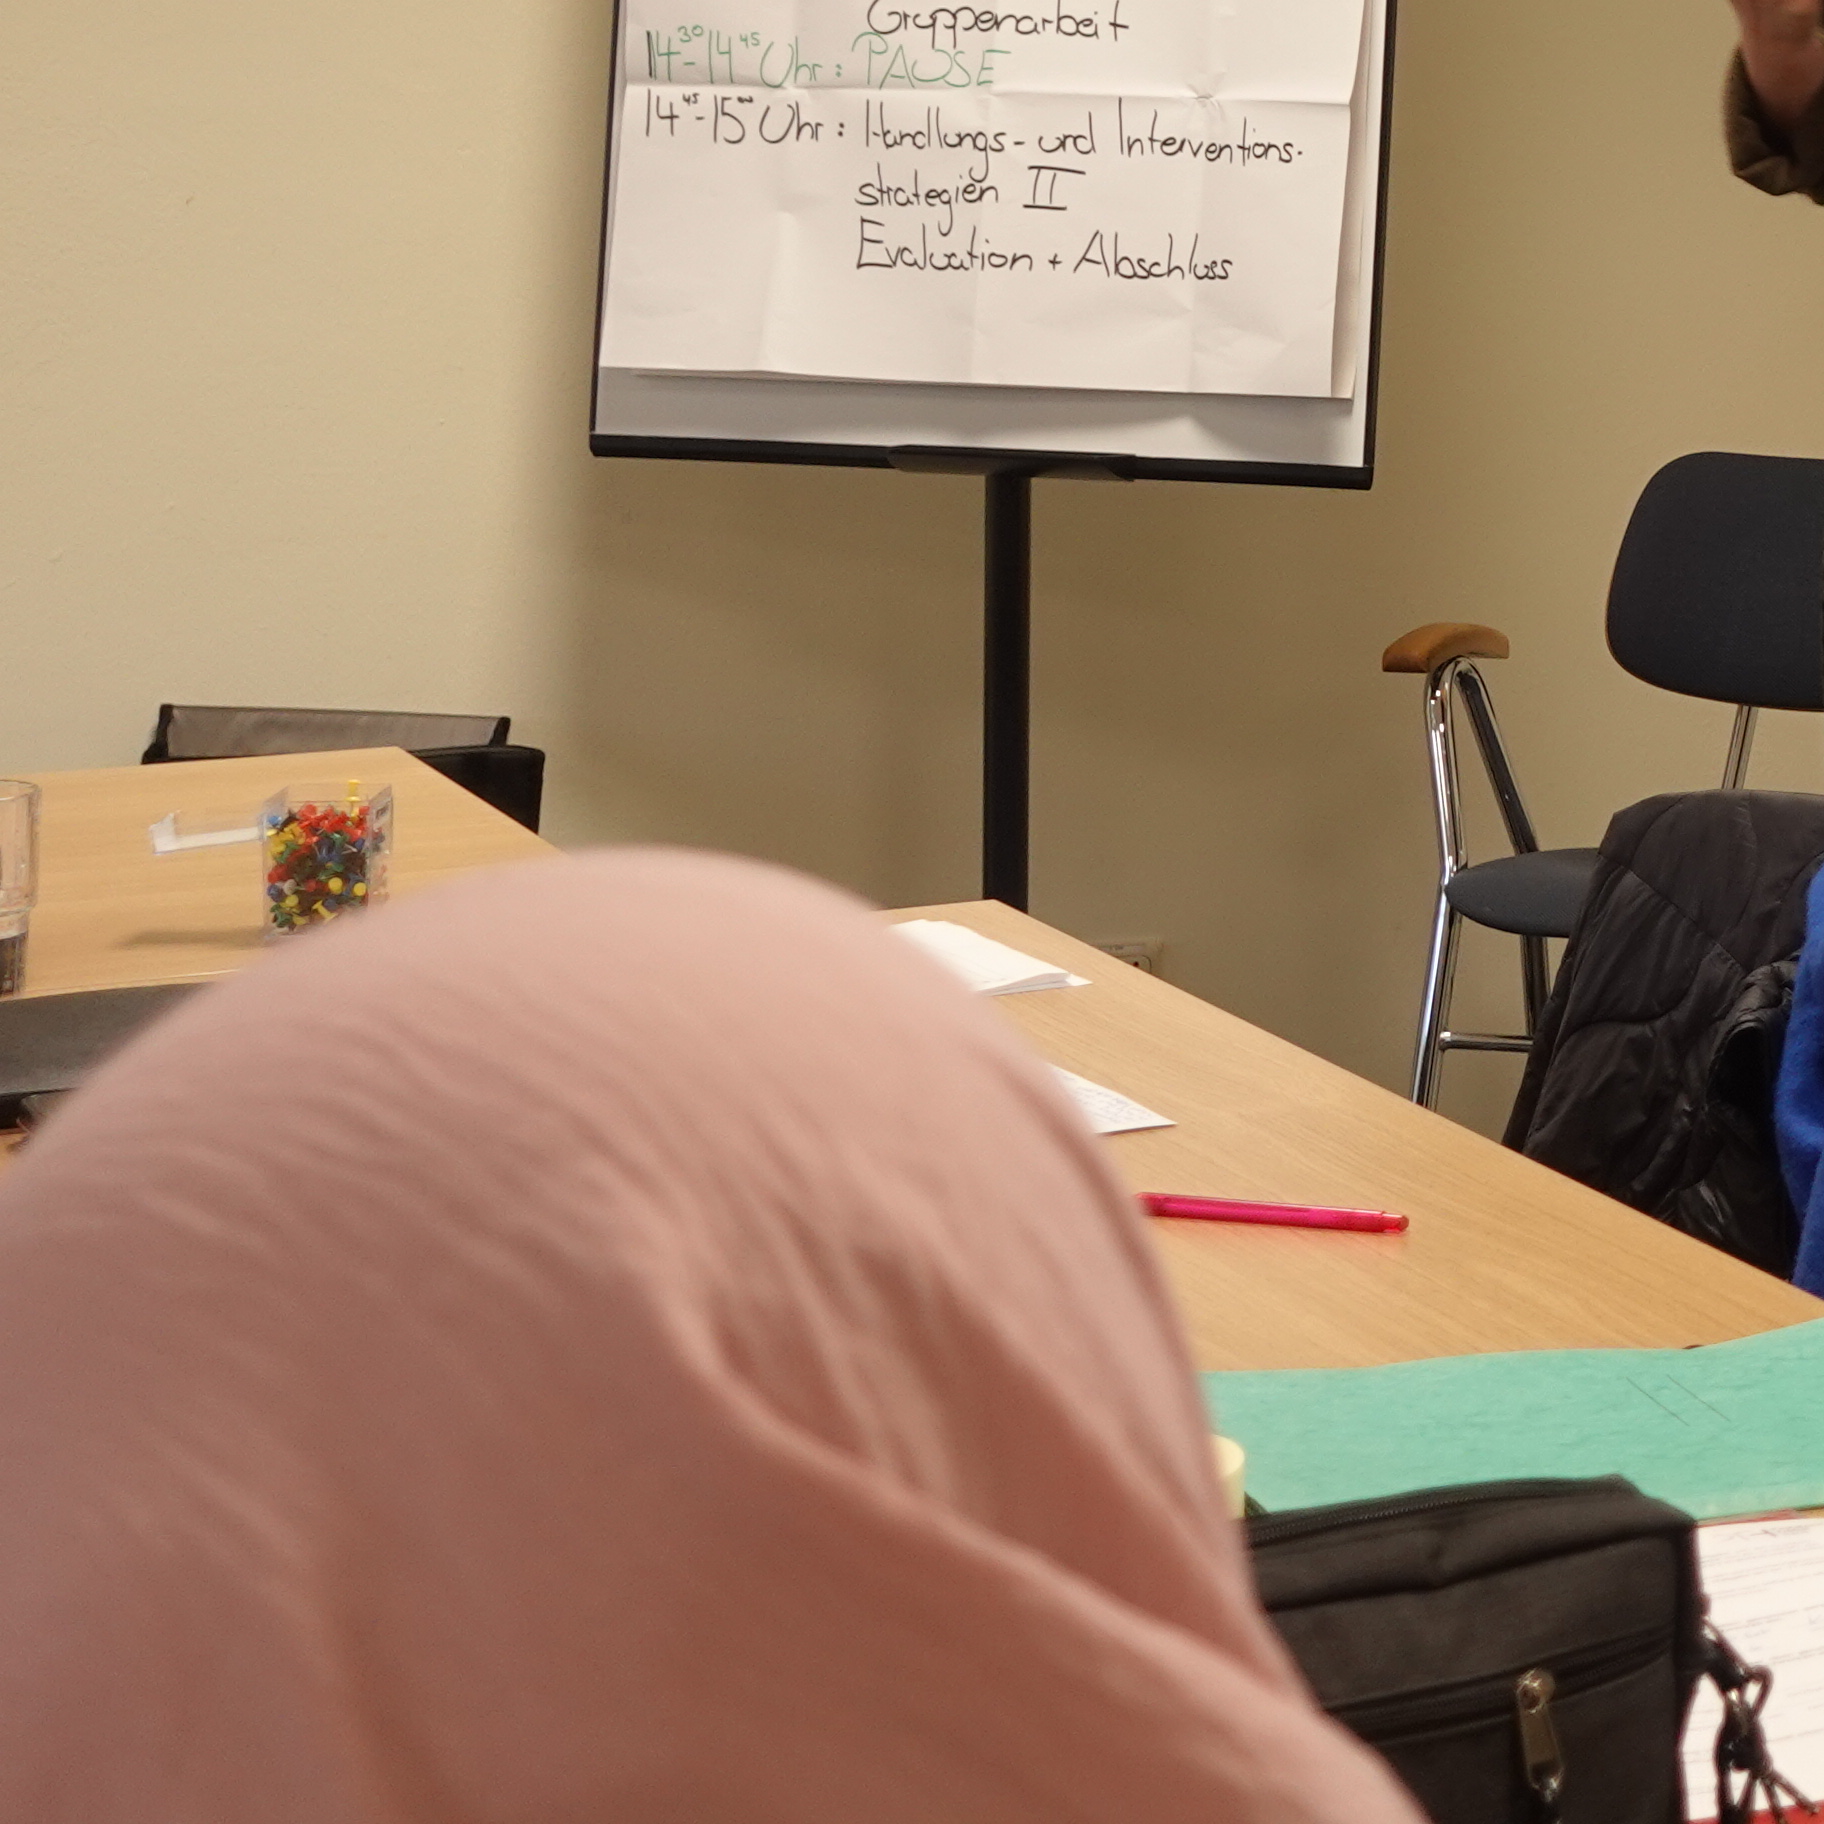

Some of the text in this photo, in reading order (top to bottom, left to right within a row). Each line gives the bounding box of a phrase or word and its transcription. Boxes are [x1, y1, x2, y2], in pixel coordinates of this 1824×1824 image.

[851, 31, 1013, 88] PAUSE
[855, 218, 1234, 282] Evaluation Abschluss
